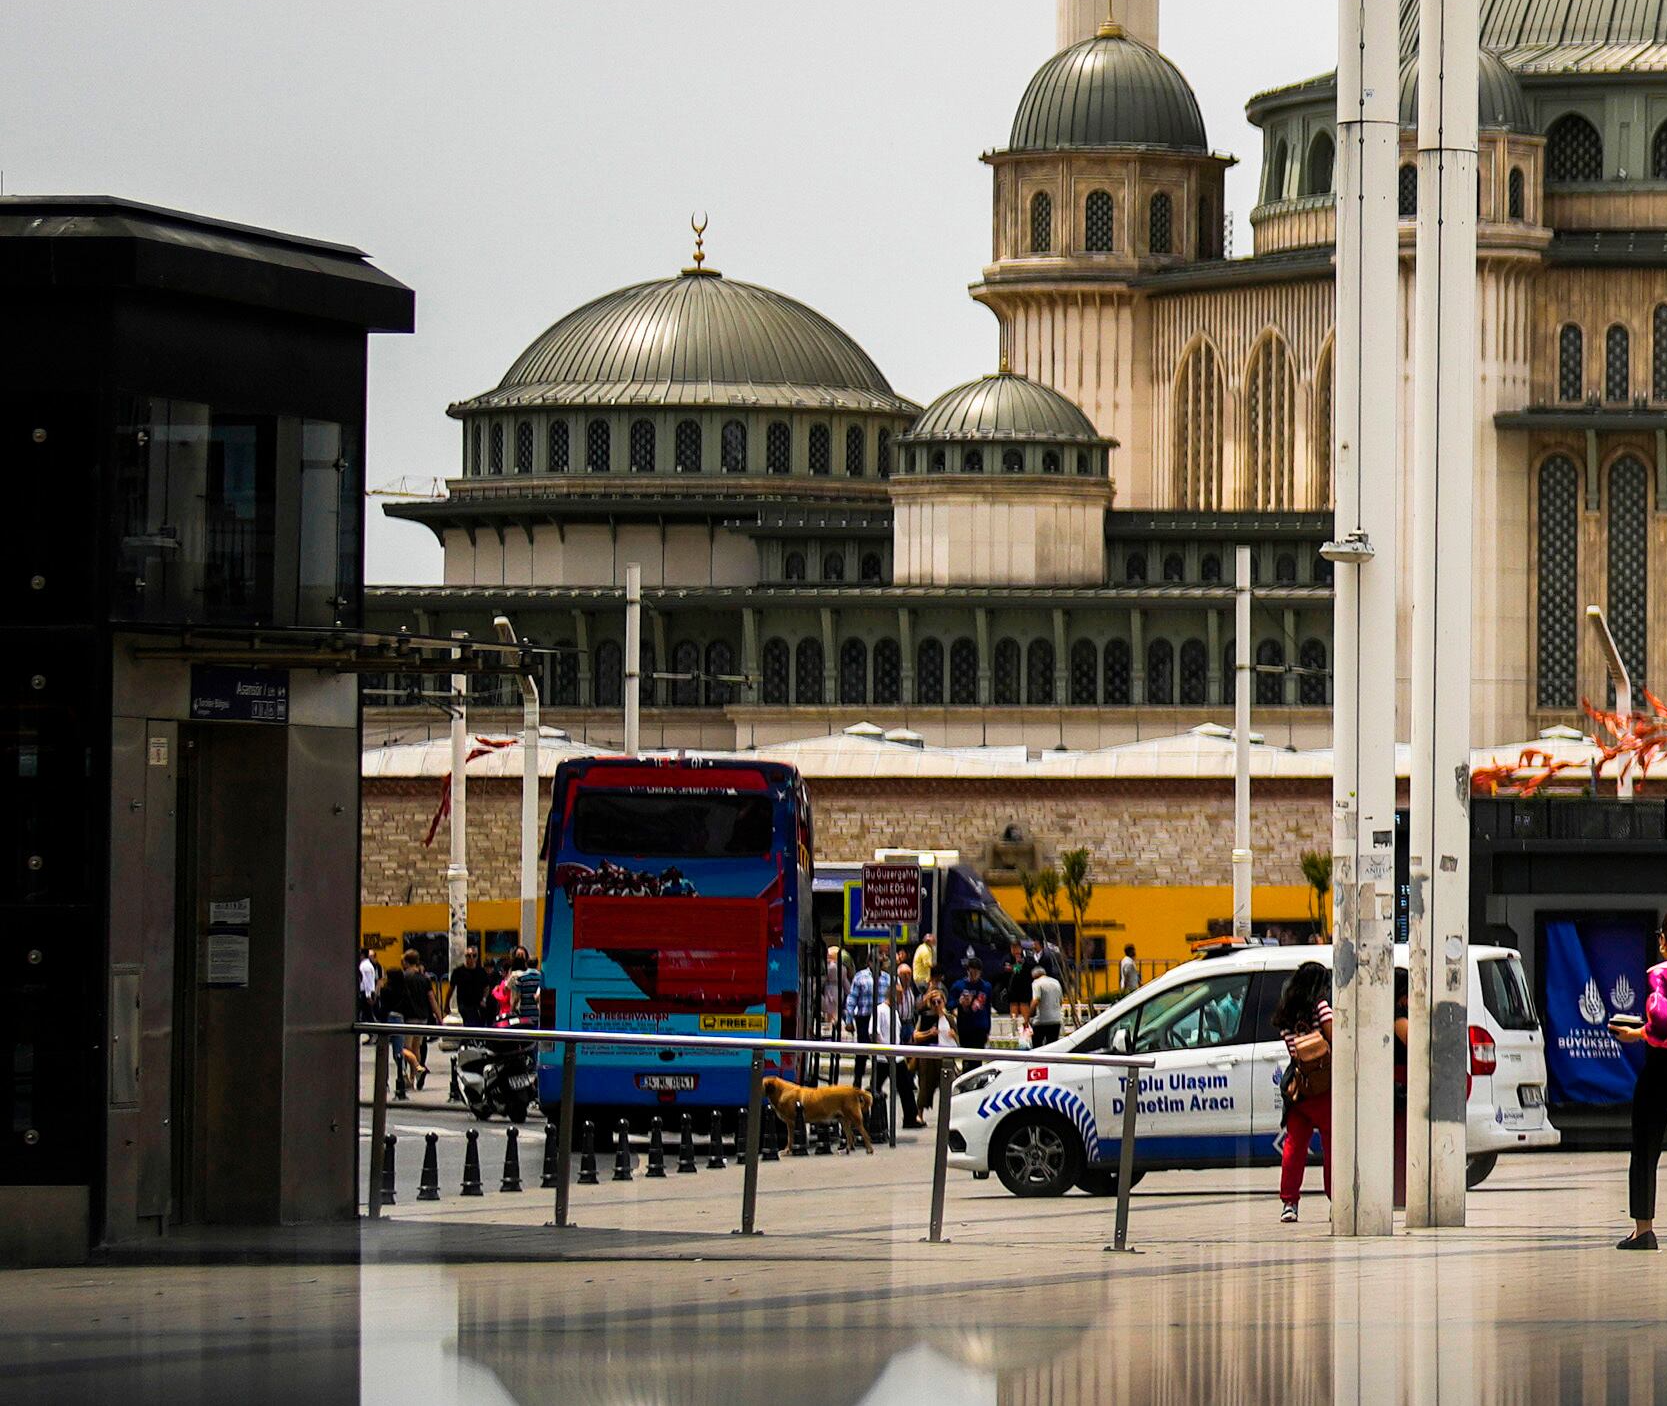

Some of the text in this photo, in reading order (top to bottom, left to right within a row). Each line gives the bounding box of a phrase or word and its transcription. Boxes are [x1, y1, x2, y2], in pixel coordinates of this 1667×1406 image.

[865, 868, 875, 880] Bu
[867, 883, 888, 894] Mobil
[874, 895, 909, 907] Denetim
[582, 1012, 603, 1022] FOR
[719, 1018, 747, 1027] FREE
[1118, 1073, 1228, 1095] Tplu Ulaşım
[1112, 1095, 1234, 1115] Dnetim Aracı
